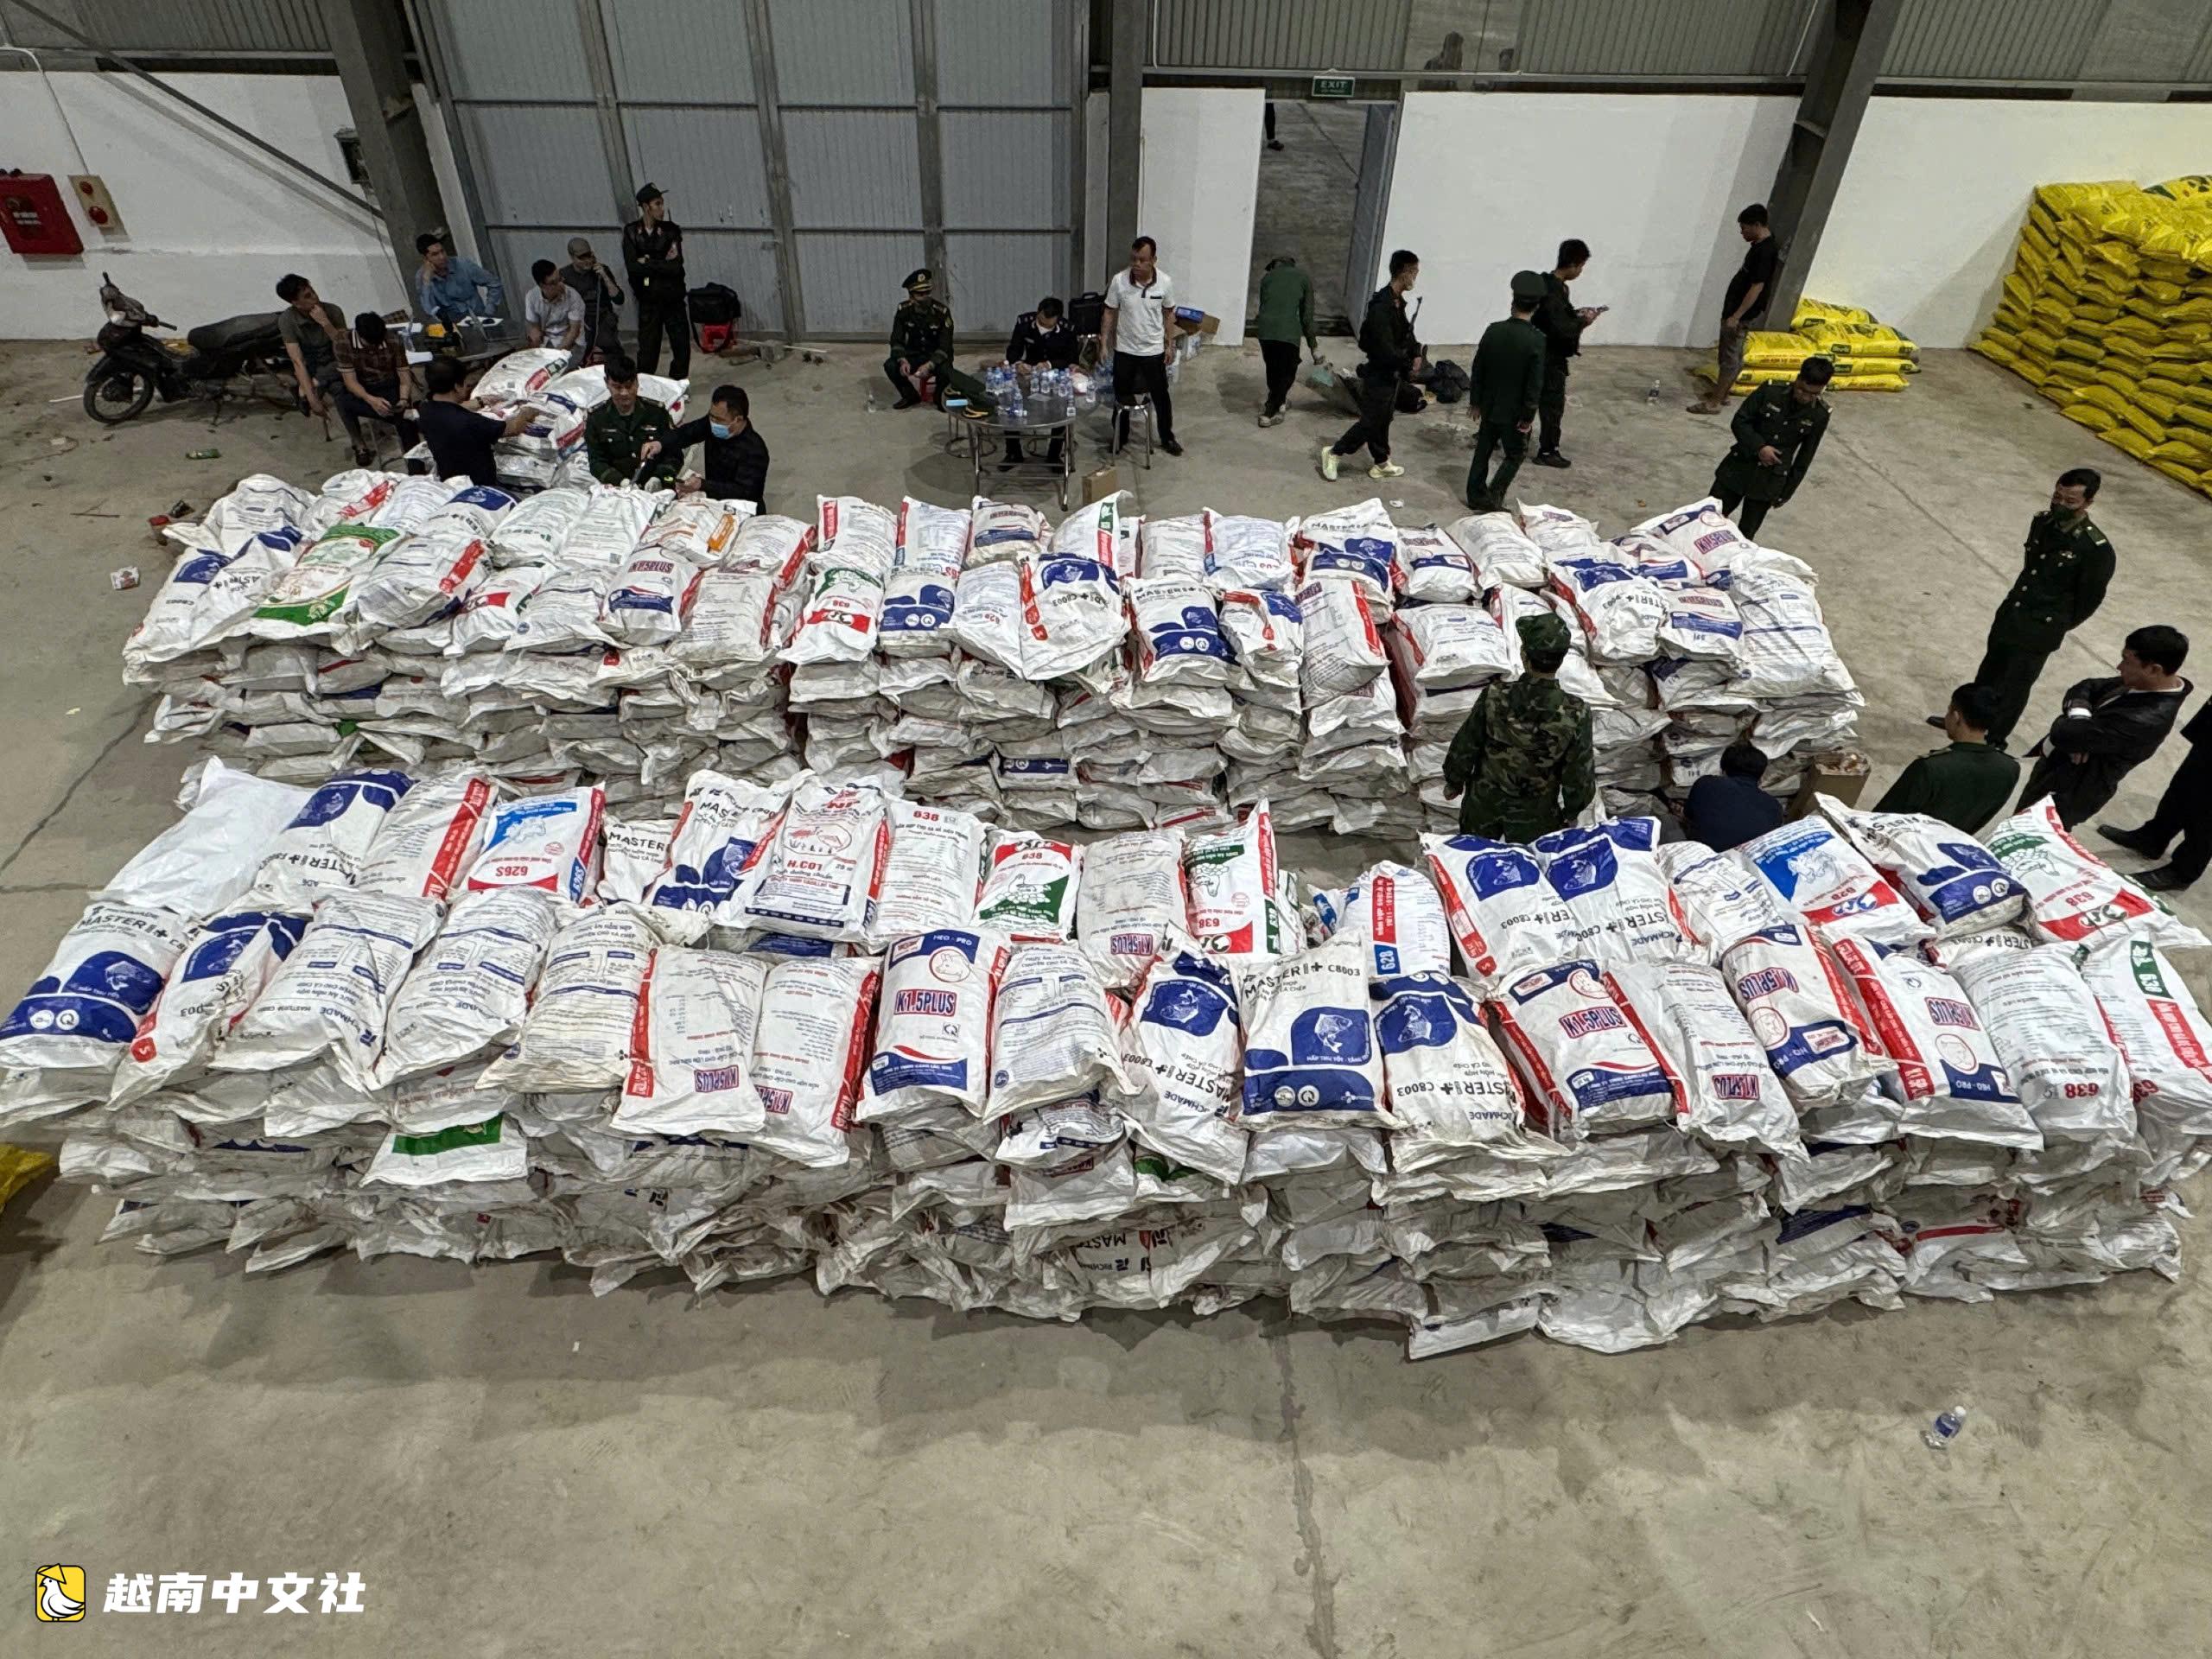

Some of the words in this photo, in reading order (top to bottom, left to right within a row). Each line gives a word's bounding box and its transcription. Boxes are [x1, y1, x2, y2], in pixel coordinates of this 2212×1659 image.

[1320, 80, 1348, 89] EXIT
[913, 810, 940, 822] 638
[608, 831, 665, 852] MASTER
[496, 866, 529, 878] 626S
[2064, 891, 2093, 906] 638
[78, 914, 148, 930] MASTER
[1198, 918, 1220, 929] 638
[1500, 913, 1531, 929] C8003
[1624, 911, 1665, 929] STER
[957, 937, 973, 946] PRO
[1576, 925, 1600, 942] C800
[2004, 935, 2030, 950] STER
[1379, 950, 1396, 970] 628
[1244, 965, 1300, 999] MASTER
[1328, 963, 1360, 976] C8003
[1738, 969, 1796, 1001] K1.5PLUS
[180, 1003, 204, 1018] 003
[896, 992, 954, 1014] K1.5PLUS
[1562, 1007, 1623, 1037] K1.5PLUS
[1123, 1052, 1154, 1071] C8003
[696, 1068, 736, 1091] K1.5PLUS
[1175, 1069, 1231, 1103] MASTER
[1955, 1080, 1971, 1089] PRO
[1397, 1081, 1434, 1097] C8003
[2063, 1084, 2100, 1099] 638
